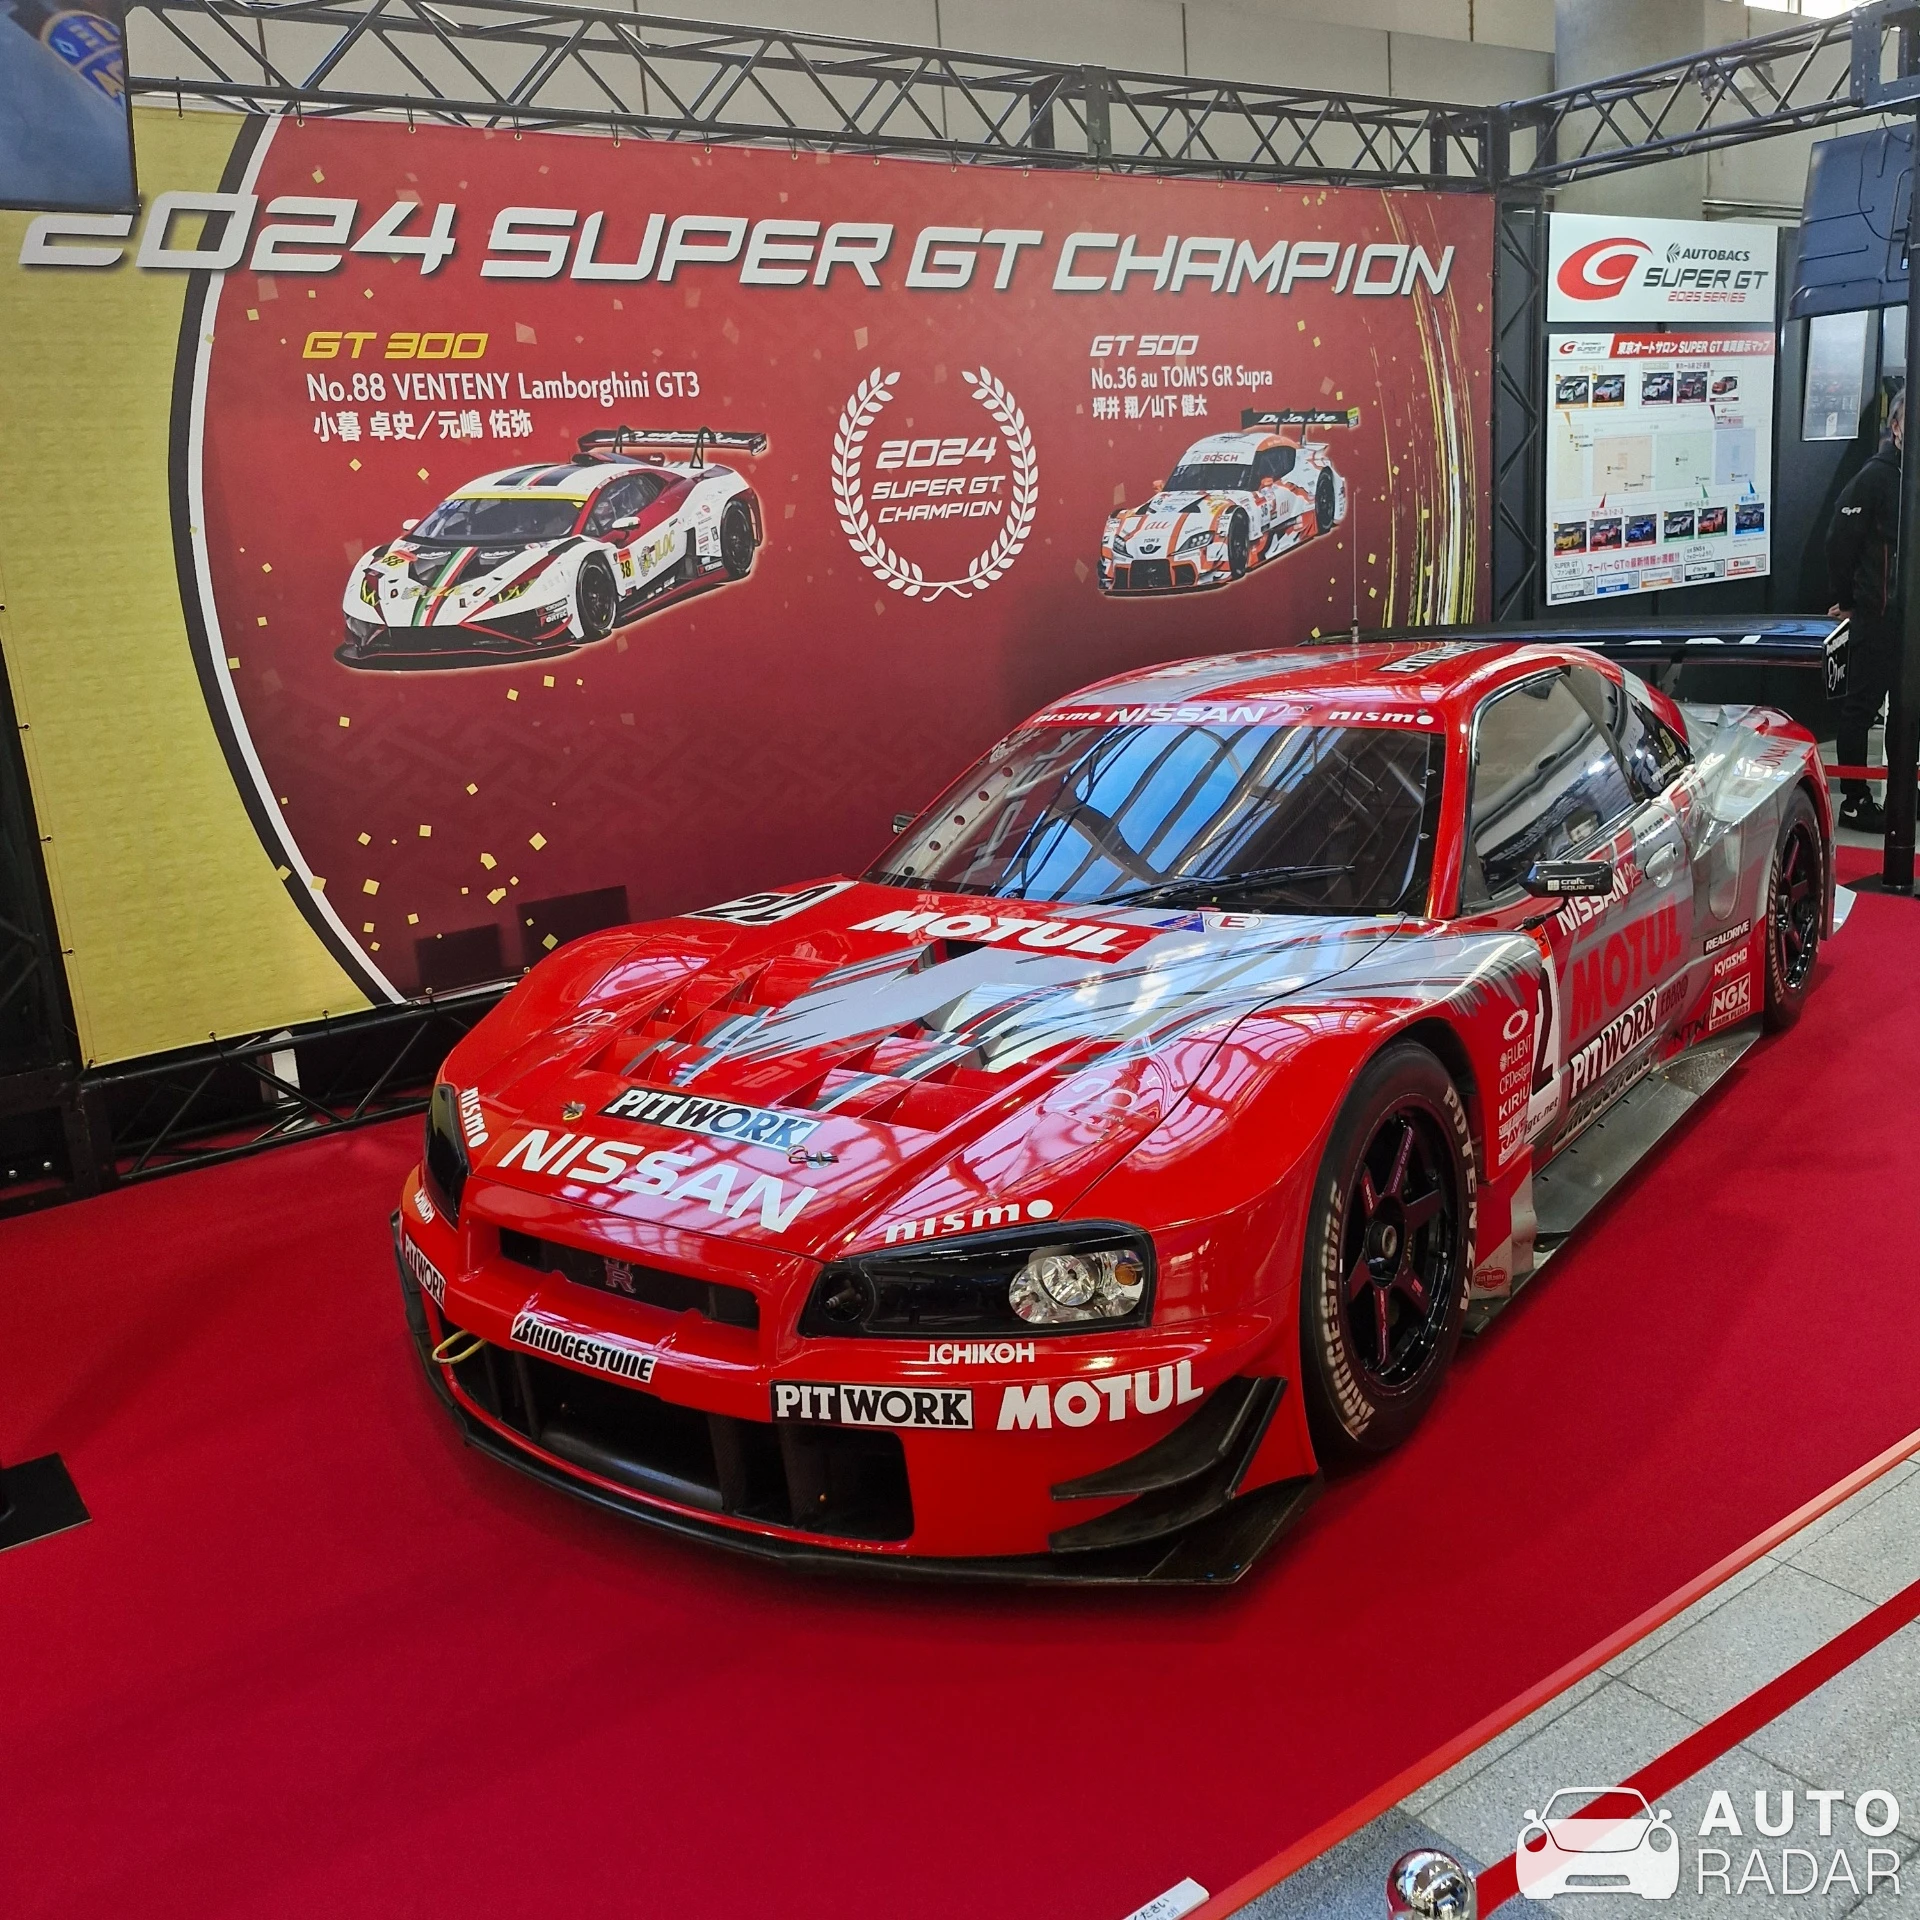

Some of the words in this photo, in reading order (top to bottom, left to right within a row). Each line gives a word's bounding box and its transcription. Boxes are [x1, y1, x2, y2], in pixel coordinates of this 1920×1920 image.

[19, 191, 456, 275] 2024
[480, 207, 894, 286] SUPER
[905, 227, 1043, 289] GT
[1052, 232, 1455, 295] CHAMPION
[1681, 248, 1750, 262] AUTOBACS
[1643, 267, 1731, 289] SUPER
[1734, 270, 1769, 289] GT
[1668, 291, 1702, 302] 2025
[1703, 292, 1747, 303] SERIES
[302, 331, 377, 358] GT
[384, 332, 489, 359] 300
[1090, 335, 1135, 357] GT
[1137, 335, 1199, 356] 500
[1679, 341, 1708, 354] SUPER
[1709, 341, 1721, 353] GT
[306, 373, 386, 402] No.88
[392, 372, 510, 401] VENTENY
[517, 371, 650, 408] Lamborghini
[655, 371, 700, 398] GT3
[1091, 367, 1137, 389] No.36
[1141, 373, 1157, 388] au
[1161, 366, 1208, 388] TOM'S
[1212, 366, 1233, 387] GR
[1236, 365, 1273, 393] Supra
[1093, 396, 1120, 420] 坪井
[1181, 394, 1208, 416] 健太
[313, 411, 362, 443] 小暮
[489, 409, 534, 438] 佑弥
[876, 437, 997, 469] 2024
[1203, 453, 1239, 463] BOSCH
[871, 478, 966, 500] SUPER
[968, 475, 1006, 495] GT
[878, 500, 1002, 523] CHAMPION
[1145, 520, 1171, 531] au
[1033, 711, 1102, 723] nismo
[1105, 706, 1265, 723] NISSAN
[1328, 710, 1434, 725] nismo
[1556, 867, 1629, 936] NISSAN
[847, 911, 1128, 953] MOTUL
[1705, 920, 1749, 953] REALDRIVE
[1568, 900, 1682, 1044] MOTUL
[1714, 946, 1748, 977] KYOSHO
[1712, 977, 1749, 1018] NGK
[1711, 1016, 1730, 1029] SPARK
[1507, 1033, 1532, 1069] FLUENT
[461, 1086, 489, 1148] nismo
[1499, 1082, 1530, 1121] KIRIU
[497, 1129, 819, 1233] NISSAN
[1443, 1086, 1478, 1311] POTENZA
[886, 1199, 1054, 1244] nismo
[512, 1315, 654, 1381] BRIDGESTONE
[928, 1342, 1036, 1366] ICHIKOH
[996, 1360, 1204, 1432] MOTUL
